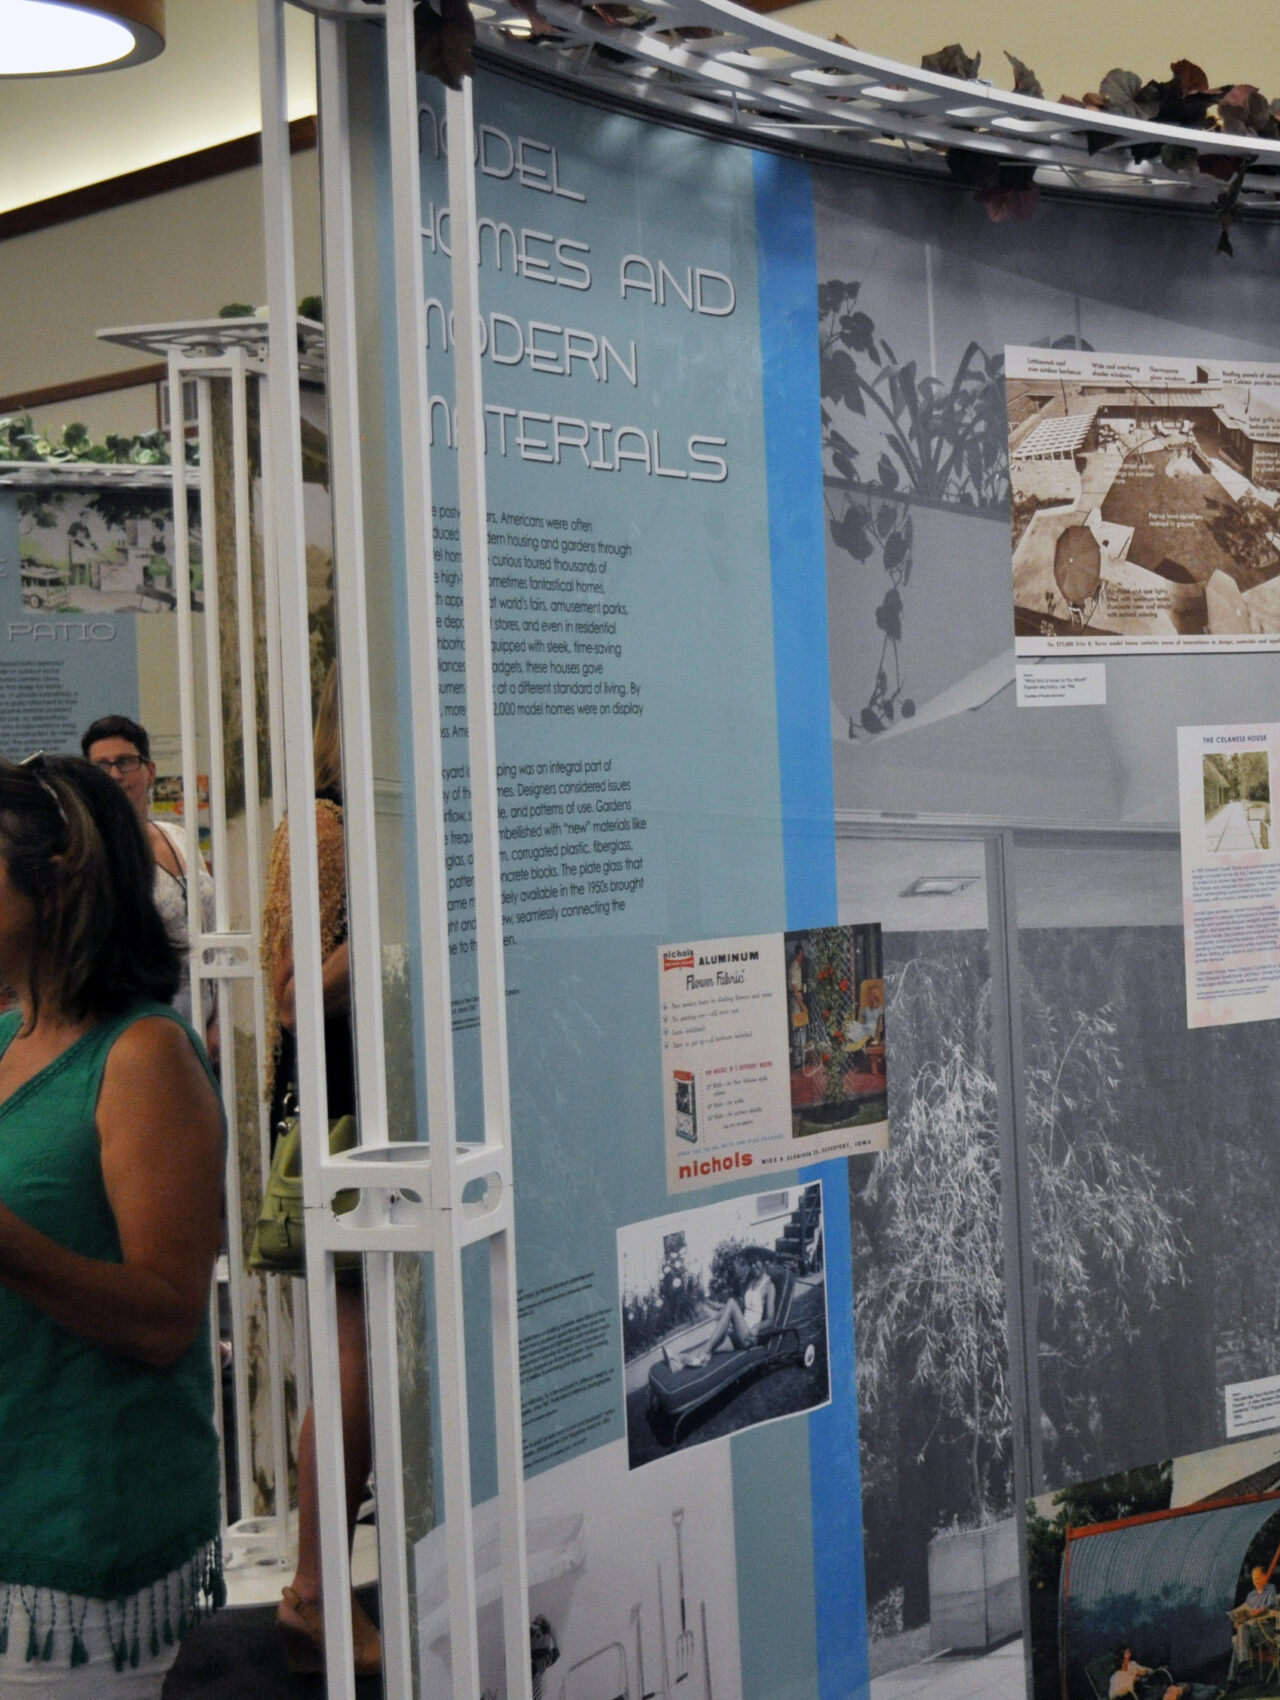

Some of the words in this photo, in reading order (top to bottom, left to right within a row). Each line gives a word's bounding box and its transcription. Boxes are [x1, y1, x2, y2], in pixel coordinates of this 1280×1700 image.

[620, 253, 736, 317] AND
[502, 512, 544, 528] Americans
[547, 519, 569, 530] were
[571, 518, 592, 532] often
[508, 532, 538, 552] housing
[541, 538, 559, 550] and
[561, 538, 596, 554] gardens
[598, 541, 632, 558] through
[492, 553, 522, 568] curious
[524, 555, 551, 570] toured
[554, 558, 597, 574] thousands
[599, 561, 608, 574] of
[530, 576, 574, 592] fantastical
[500, 596, 528, 610] world's
[550, 600, 600, 614] amusement
[7, 622, 117, 642] PATIO
[522, 619, 539, 632] and
[541, 622, 563, 633] even
[565, 619, 573, 633] in
[575, 620, 617, 634] residential
[528, 640, 545, 652] with
[574, 640, 622, 657] time-saving
[526, 660, 548, 674] these
[550, 661, 580, 674] houses
[582, 663, 603, 677] gave
[497, 681, 507, 694] at
[509, 684, 516, 694] a
[518, 681, 551, 694] different
[553, 681, 592, 695] standard
[594, 681, 602, 694] of
[630, 681, 641, 696] By
[445, 705, 466, 716] more
[517, 702, 544, 716] model
[545, 702, 575, 715] homes
[577, 705, 598, 715] were
[600, 704, 610, 714] on
[612, 701, 644, 716] display
[1215, 735, 1246, 743] CELANESE
[519, 764, 535, 775] was
[536, 764, 548, 774] an
[549, 760, 582, 776] integral
[584, 760, 602, 775] part
[603, 759, 612, 772] of
[452, 786, 461, 800] of
[518, 783, 556, 798] Designers
[559, 780, 606, 794] considered
[608, 779, 631, 792] issues
[510, 804, 528, 818] and
[530, 803, 564, 820] patterns
[566, 800, 575, 814] of
[595, 799, 632, 812] Gardens
[544, 822, 561, 836] with
[593, 818, 630, 832] materials
[632, 816, 647, 830] like
[511, 843, 558, 861] corrugated
[561, 863, 577, 876] The
[579, 861, 602, 878] plate
[602, 860, 624, 875] glass
[624, 856, 643, 870] that
[520, 886, 558, 902] available
[560, 884, 568, 897] in
[570, 883, 585, 896] the
[588, 880, 609, 894] 1950s
[610, 877, 644, 893] brought
[516, 906, 559, 924] seamlessly
[561, 899, 610, 918] connecting
[611, 898, 626, 911] the
[663, 949, 694, 959] nichols
[698, 951, 759, 966] ALUMINUM
[686, 974, 714, 991] Flower
[679, 1152, 753, 1179] nichols
